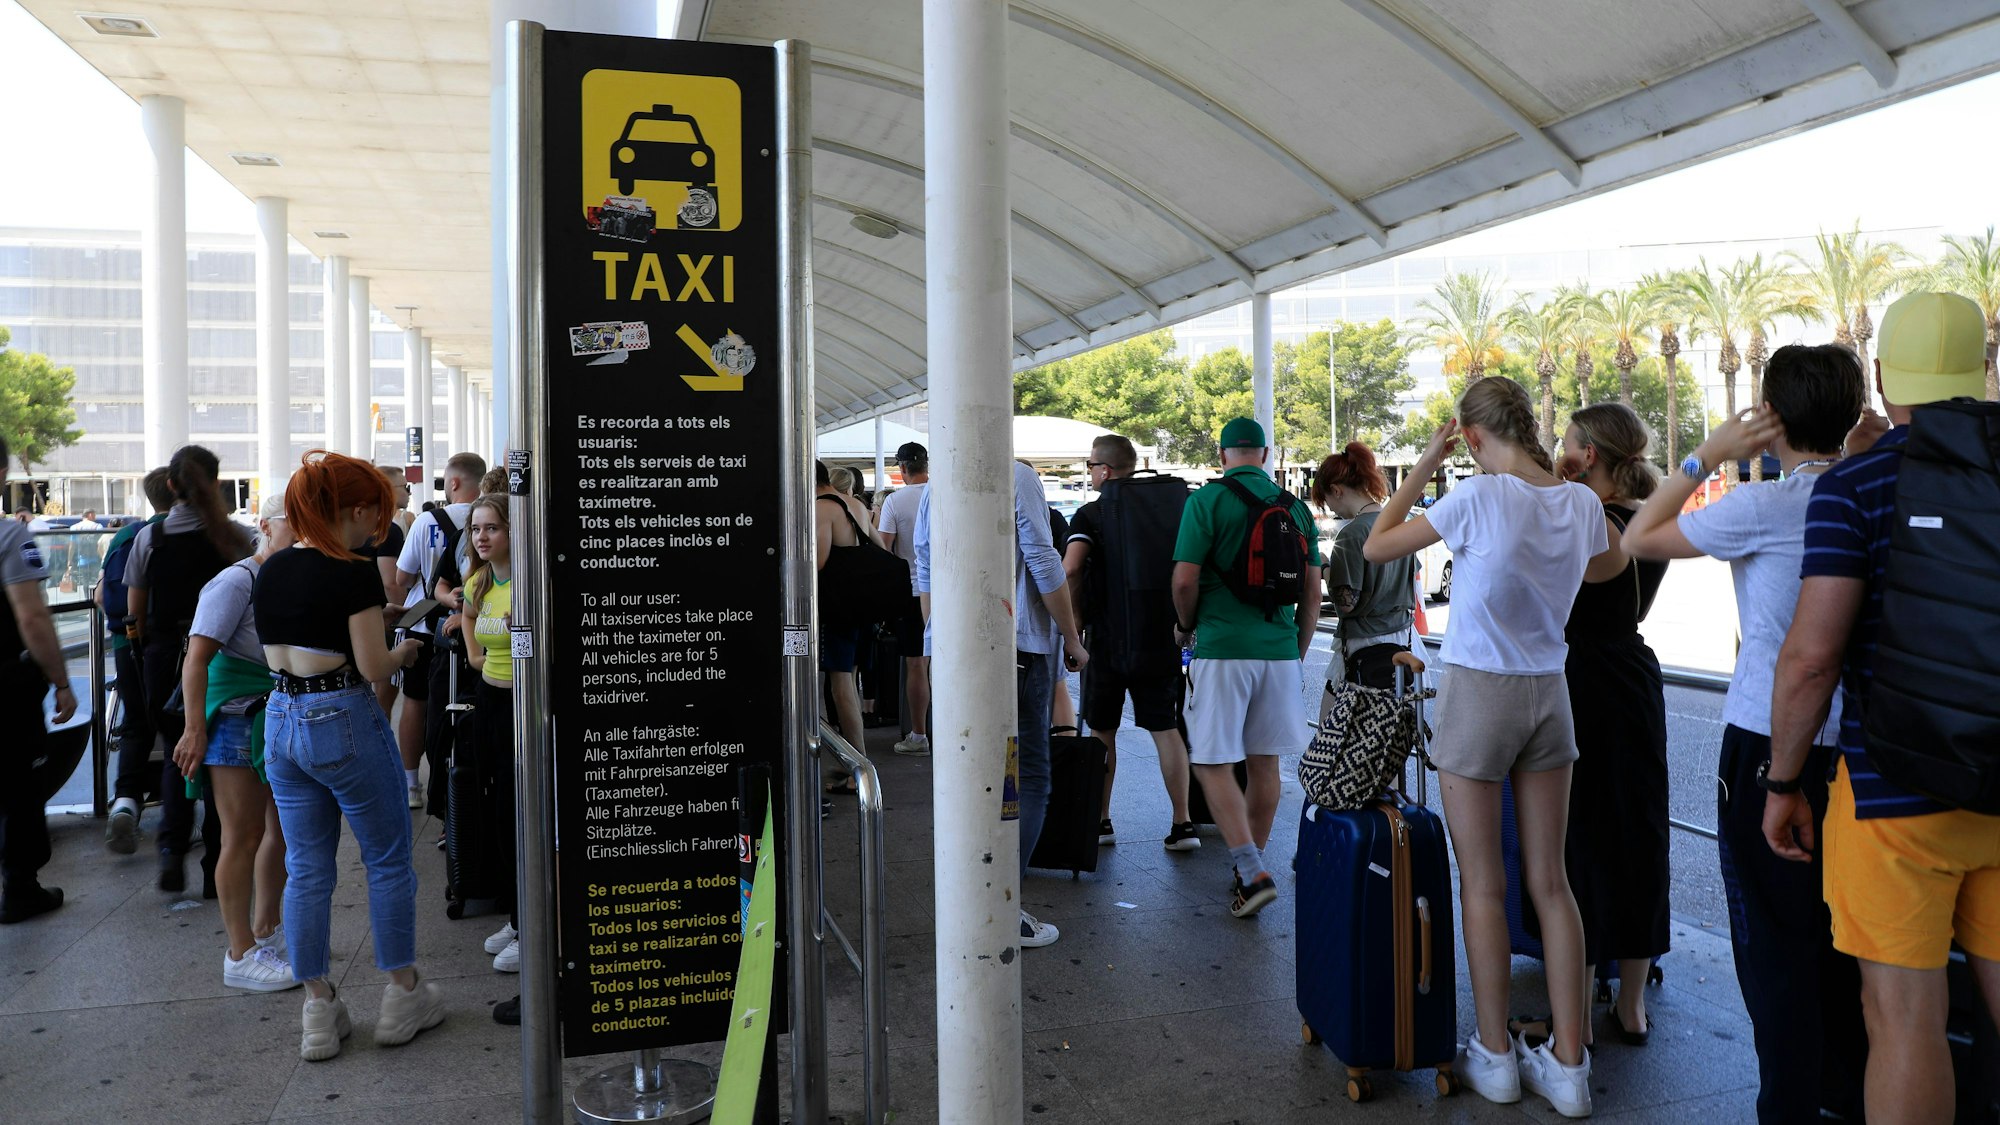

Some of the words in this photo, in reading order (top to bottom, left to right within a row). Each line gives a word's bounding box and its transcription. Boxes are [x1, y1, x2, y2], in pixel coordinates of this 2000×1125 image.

[592, 252, 735, 302] TAXI
[578, 415, 595, 428] Es
[601, 416, 659, 428] recorda
[664, 419, 672, 428] a
[677, 417, 705, 428] tots
[710, 416, 730, 428] els
[579, 436, 637, 448] usuaris:
[578, 456, 608, 468] Tots
[614, 455, 635, 468] els
[640, 455, 692, 468] serveis
[697, 455, 715, 468] de
[719, 455, 746, 467] taxi
[579, 479, 596, 488] es
[601, 475, 681, 488] realitzaran
[687, 475, 718, 487] amb
[579, 496, 655, 508] taxímetre.
[579, 516, 609, 528] Tots
[615, 515, 636, 528] els
[641, 514, 700, 527] vehicles
[706, 517, 730, 526] son
[736, 513, 752, 526] de
[580, 536, 611, 548] cinc
[617, 535, 664, 551] places
[670, 534, 712, 546] inclòs
[717, 533, 729, 546] el
[581, 555, 659, 568] conductor.
[581, 593, 596, 606] To
[602, 593, 615, 606] all
[621, 595, 642, 605] our
[647, 594, 679, 604] user:
[582, 613, 596, 626] All
[602, 611, 681, 625] taxiservices
[686, 610, 713, 622] take
[719, 609, 752, 624] place
[582, 632, 608, 645] with
[613, 632, 634, 644] the
[639, 630, 701, 643] taximeter
[706, 631, 725, 641] on.
[582, 652, 597, 665] All
[603, 651, 656, 664] vehicles
[661, 652, 681, 662] are
[686, 648, 704, 661] for
[710, 647, 717, 660] 5
[583, 673, 641, 687] persons,
[647, 667, 701, 682] included
[705, 667, 725, 679] the
[583, 690, 648, 704] taxidriver.
[584, 729, 600, 742] An
[606, 728, 628, 741] alle
[633, 725, 699, 741] fahrgäste:
[584, 748, 608, 761] Alle
[613, 745, 685, 760] Taxifahrten
[691, 742, 743, 756] erfolgen
[586, 768, 606, 781] mit
[611, 762, 728, 780] Fahrpreisanzeiger
[586, 783, 667, 801] (Taxameter).
[586, 807, 609, 819] Alle
[615, 804, 683, 818] Fahrzeuge
[688, 800, 727, 813] haben
[587, 824, 656, 840] Sitzplätze.
[587, 840, 687, 859] (Einschliesslich
[589, 884, 606, 897] Se
[612, 879, 678, 895] recuerda
[684, 880, 692, 889] a
[697, 874, 736, 888] todos
[589, 904, 609, 916] los
[615, 899, 681, 914] usuarios:
[589, 922, 632, 935] Todos
[637, 920, 657, 931] los
[663, 914, 726, 929] servicios
[732, 911, 741, 923] d
[589, 941, 616, 955] taxi
[622, 942, 638, 952] se
[644, 933, 717, 950] realizarán
[590, 959, 665, 974] taxímetro.
[591, 980, 633, 994] Todos
[639, 977, 659, 989] los
[664, 970, 731, 986] vehículos
[592, 1001, 609, 1013] de
[615, 998, 624, 1011] 5
[630, 996, 676, 1012] plazas
[592, 1016, 669, 1032] conductor.
